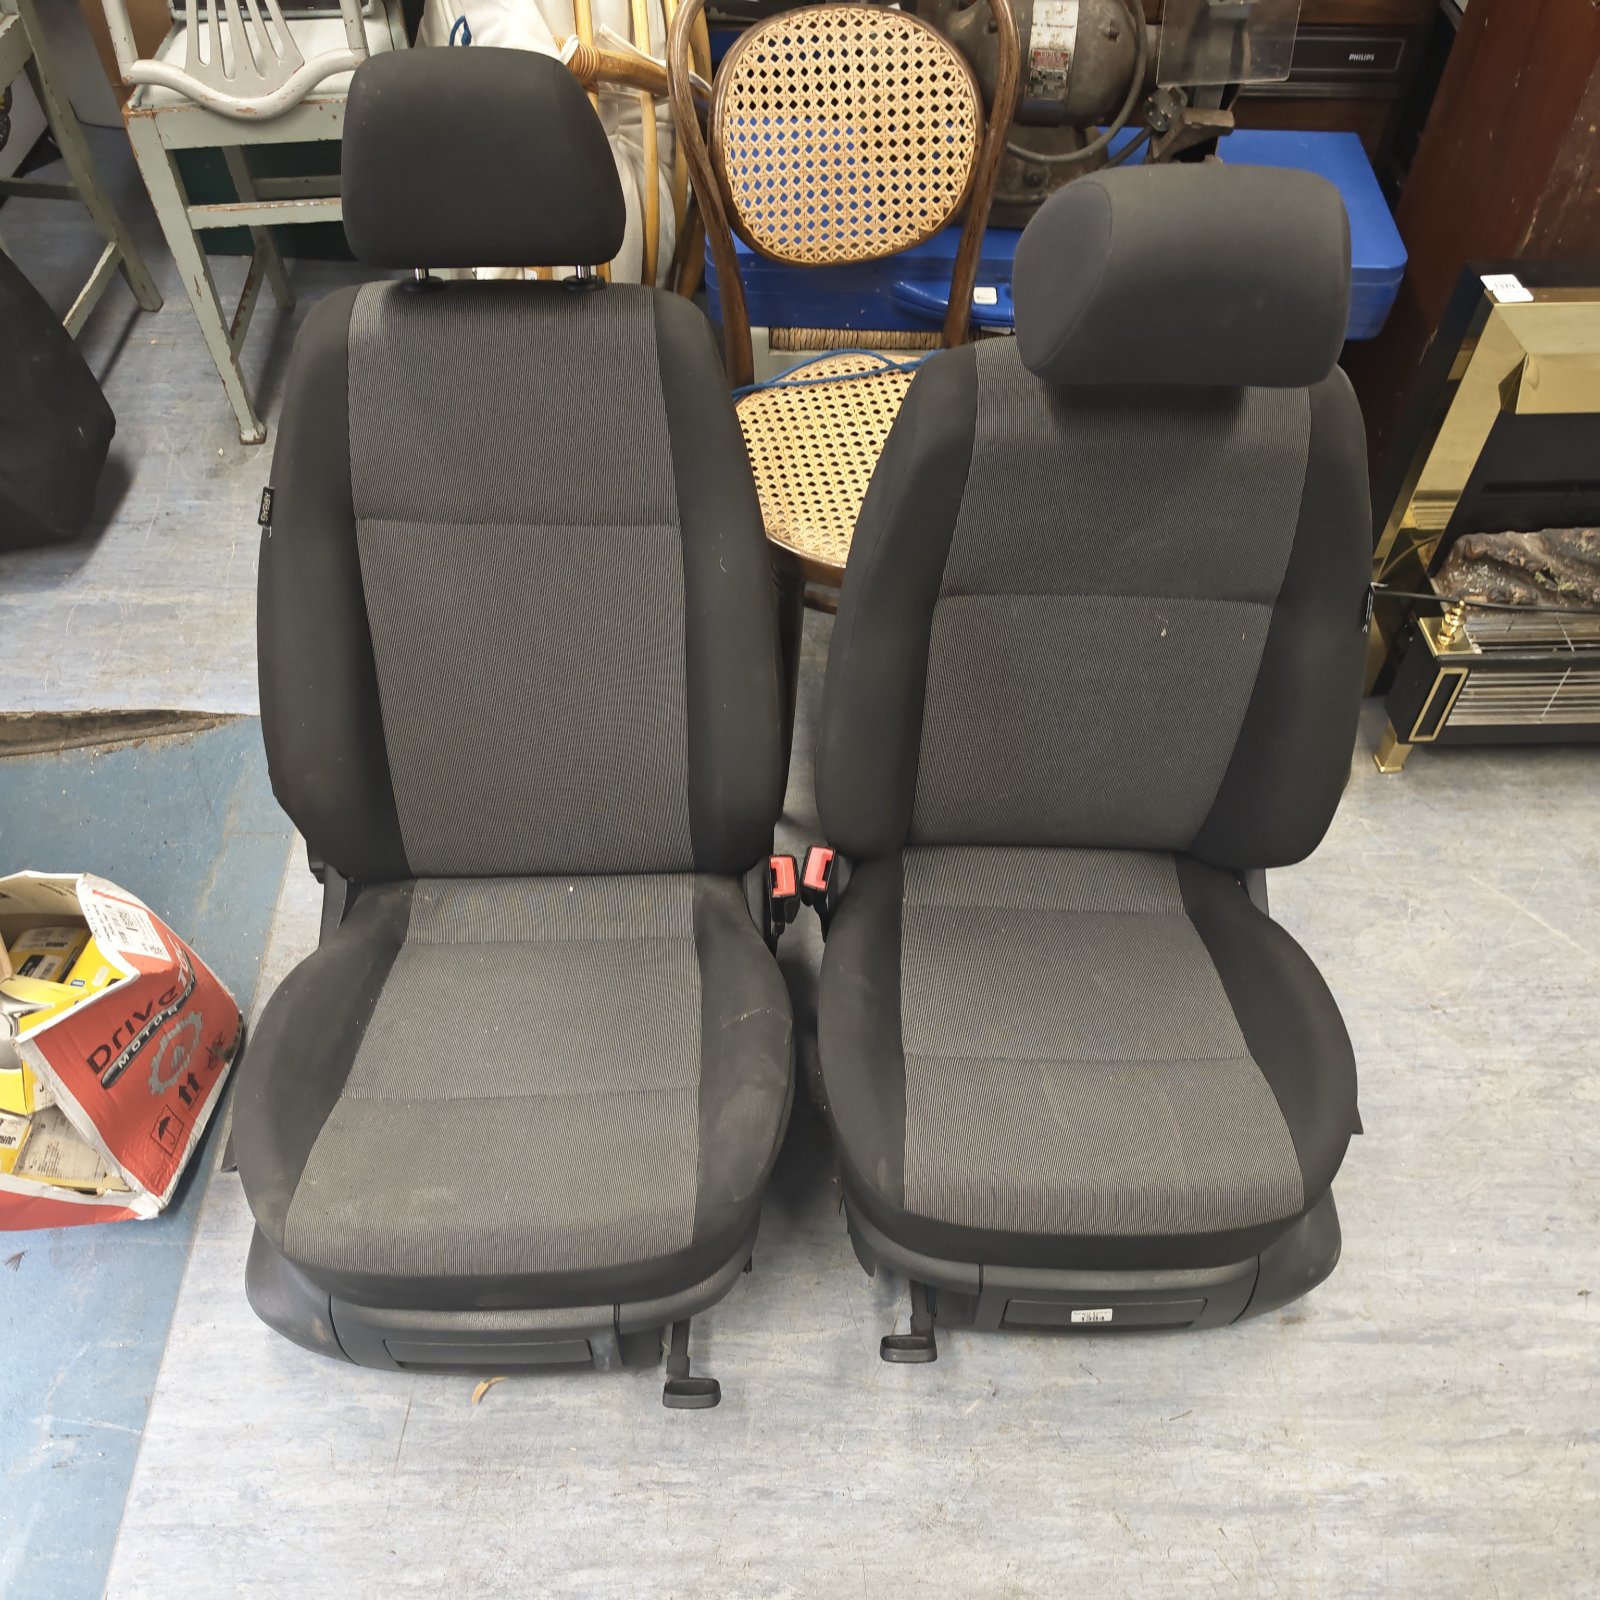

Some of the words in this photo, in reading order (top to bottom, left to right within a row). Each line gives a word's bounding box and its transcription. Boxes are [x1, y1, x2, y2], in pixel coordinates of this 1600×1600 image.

[1349, 53, 1375, 61] PHILIPS
[260, 491, 271, 522] AIRBAG
[118, 1004, 178, 1069] MOTOR
